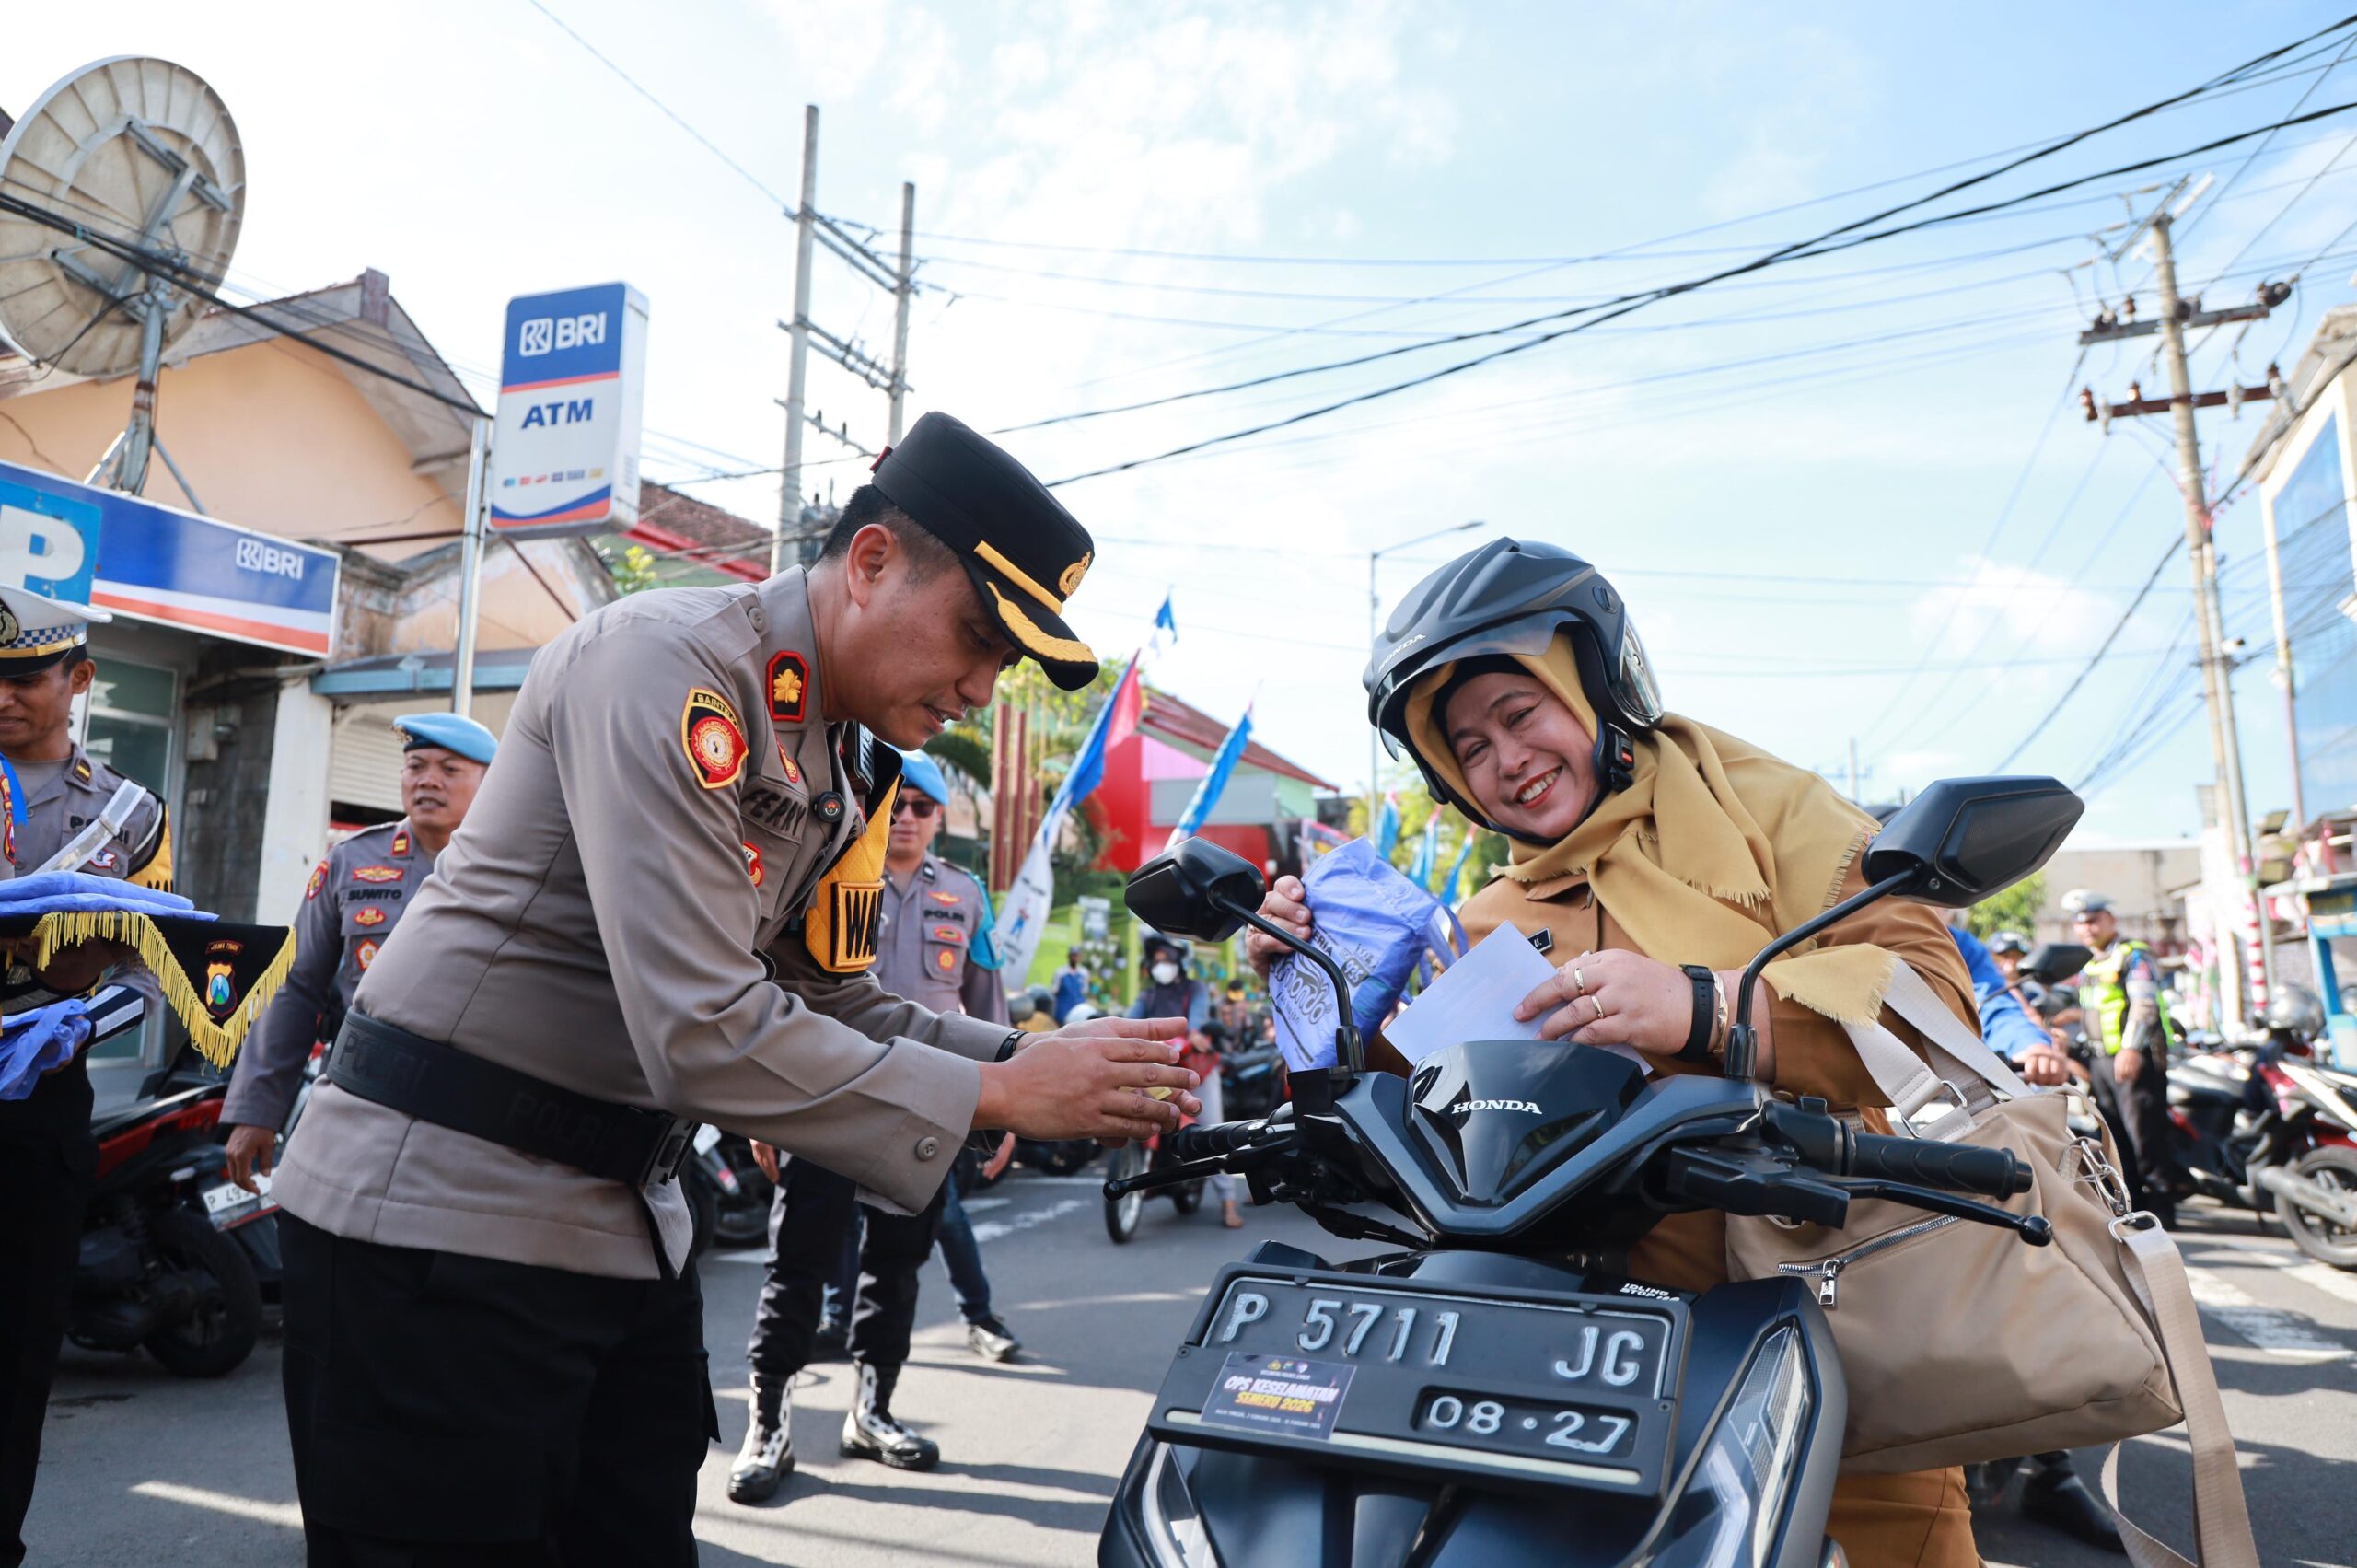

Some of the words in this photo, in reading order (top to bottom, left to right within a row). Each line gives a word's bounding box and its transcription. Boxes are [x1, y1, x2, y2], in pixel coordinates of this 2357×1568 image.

[555, 311, 607, 350] BRI
[520, 398, 594, 429] ATM
[0, 505, 84, 589] P
[263, 547, 304, 581] BRI
[1377, 633, 1427, 673] HONDA
[348, 889, 402, 900] SUWITO
[923, 909, 965, 922] POLRI
[1344, 959, 1364, 983] 935
[1451, 1099, 1543, 1115] HONDA
[1620, 1287, 1656, 1297] STOP
[1624, 1283, 1670, 1296] IDLING
[1222, 1292, 1270, 1342] P
[1295, 1299, 1462, 1366] 5711
[1553, 1326, 1645, 1387] JG
[1224, 1375, 1253, 1391] OPS
[1250, 1378, 1340, 1403] KESELAMATAN
[1235, 1391, 1283, 1409] SEMERU
[1279, 1398, 1317, 1414] 2026
